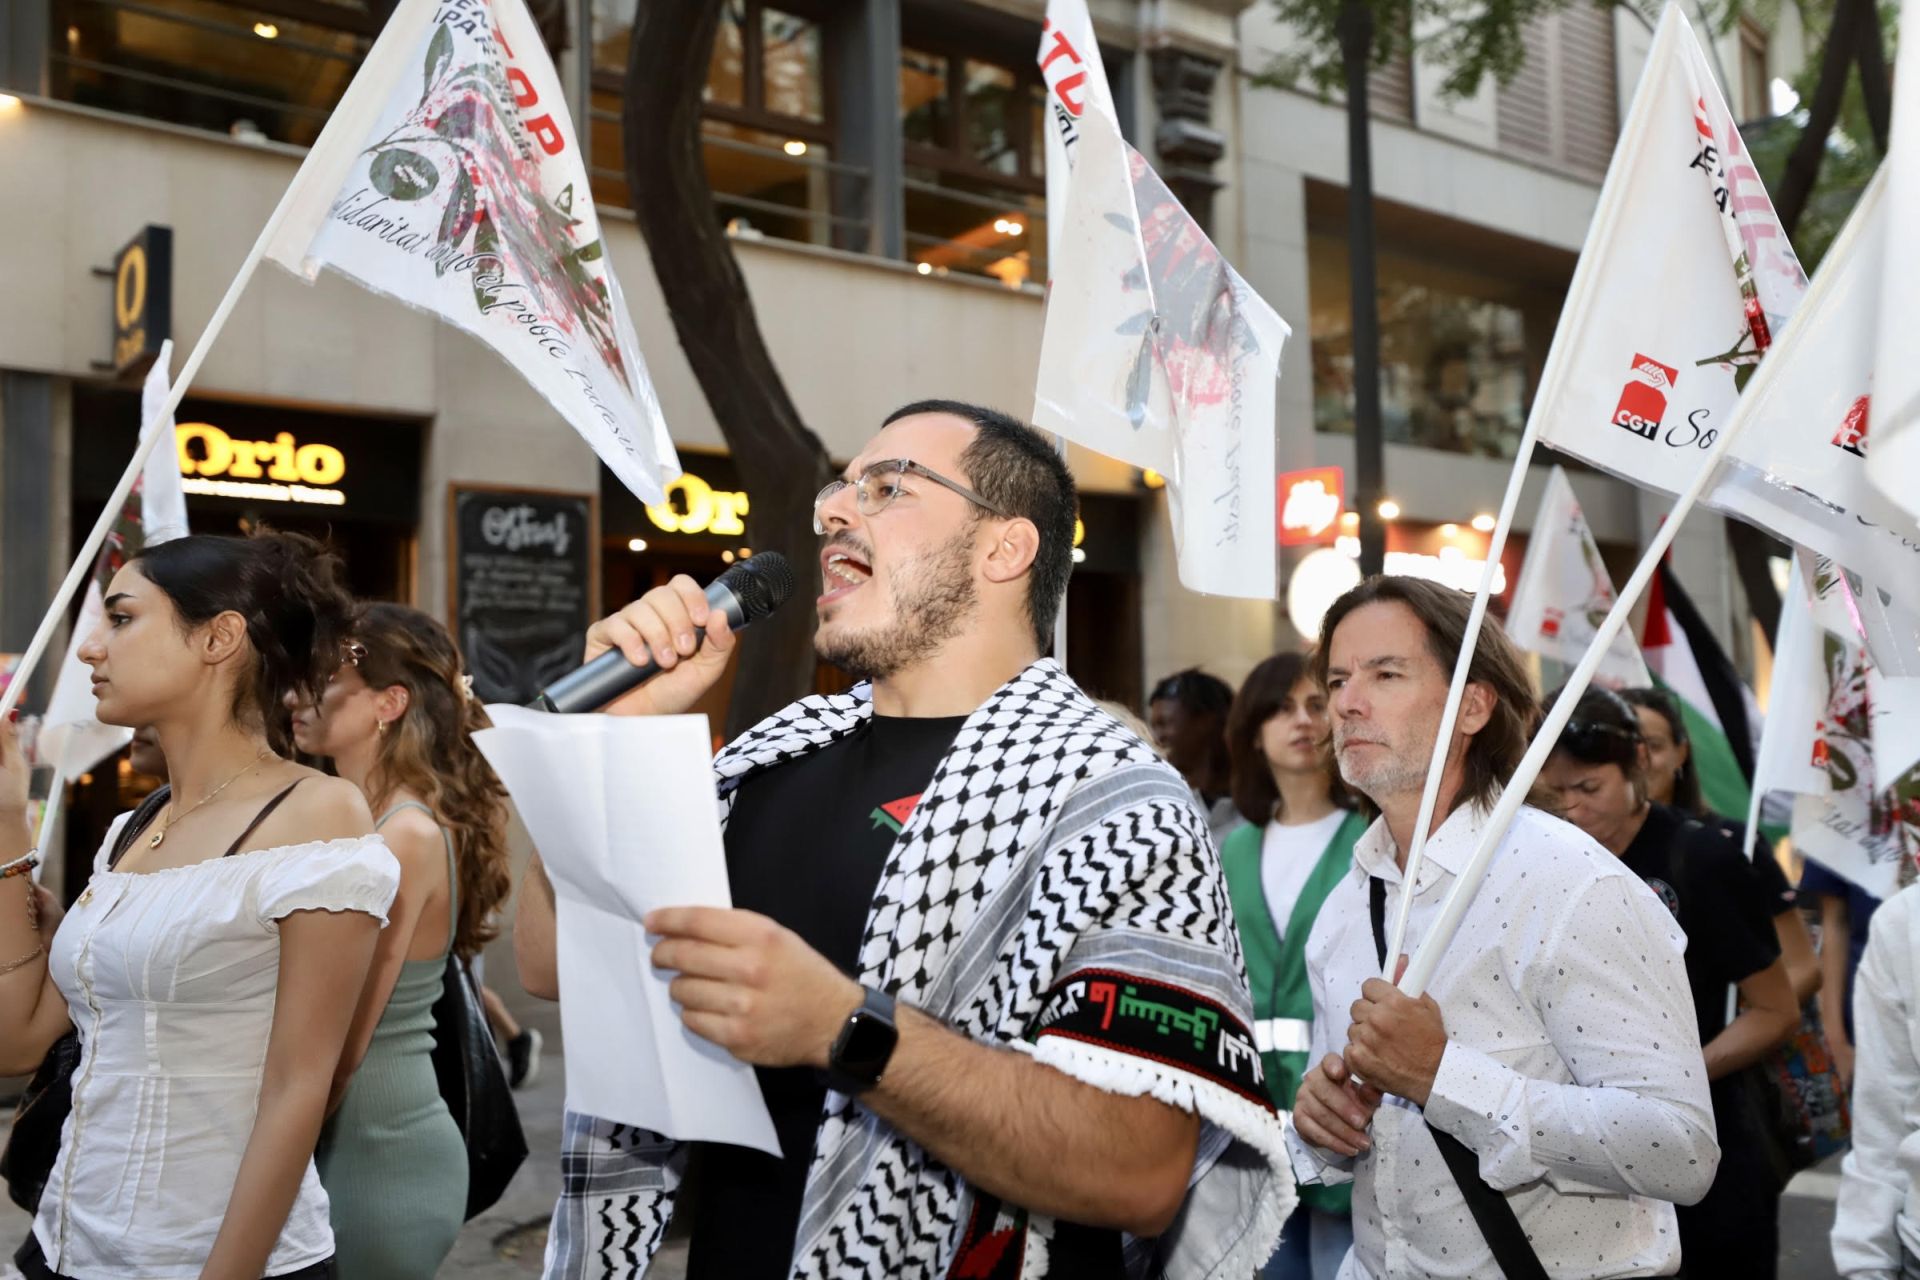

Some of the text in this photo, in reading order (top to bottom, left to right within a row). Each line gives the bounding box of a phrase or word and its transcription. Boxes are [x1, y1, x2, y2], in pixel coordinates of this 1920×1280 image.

[486, 14, 565, 156] TOP
[175, 422, 346, 485] Orio
[1616, 409, 1658, 437] CGT
[646, 472, 750, 535] Or
